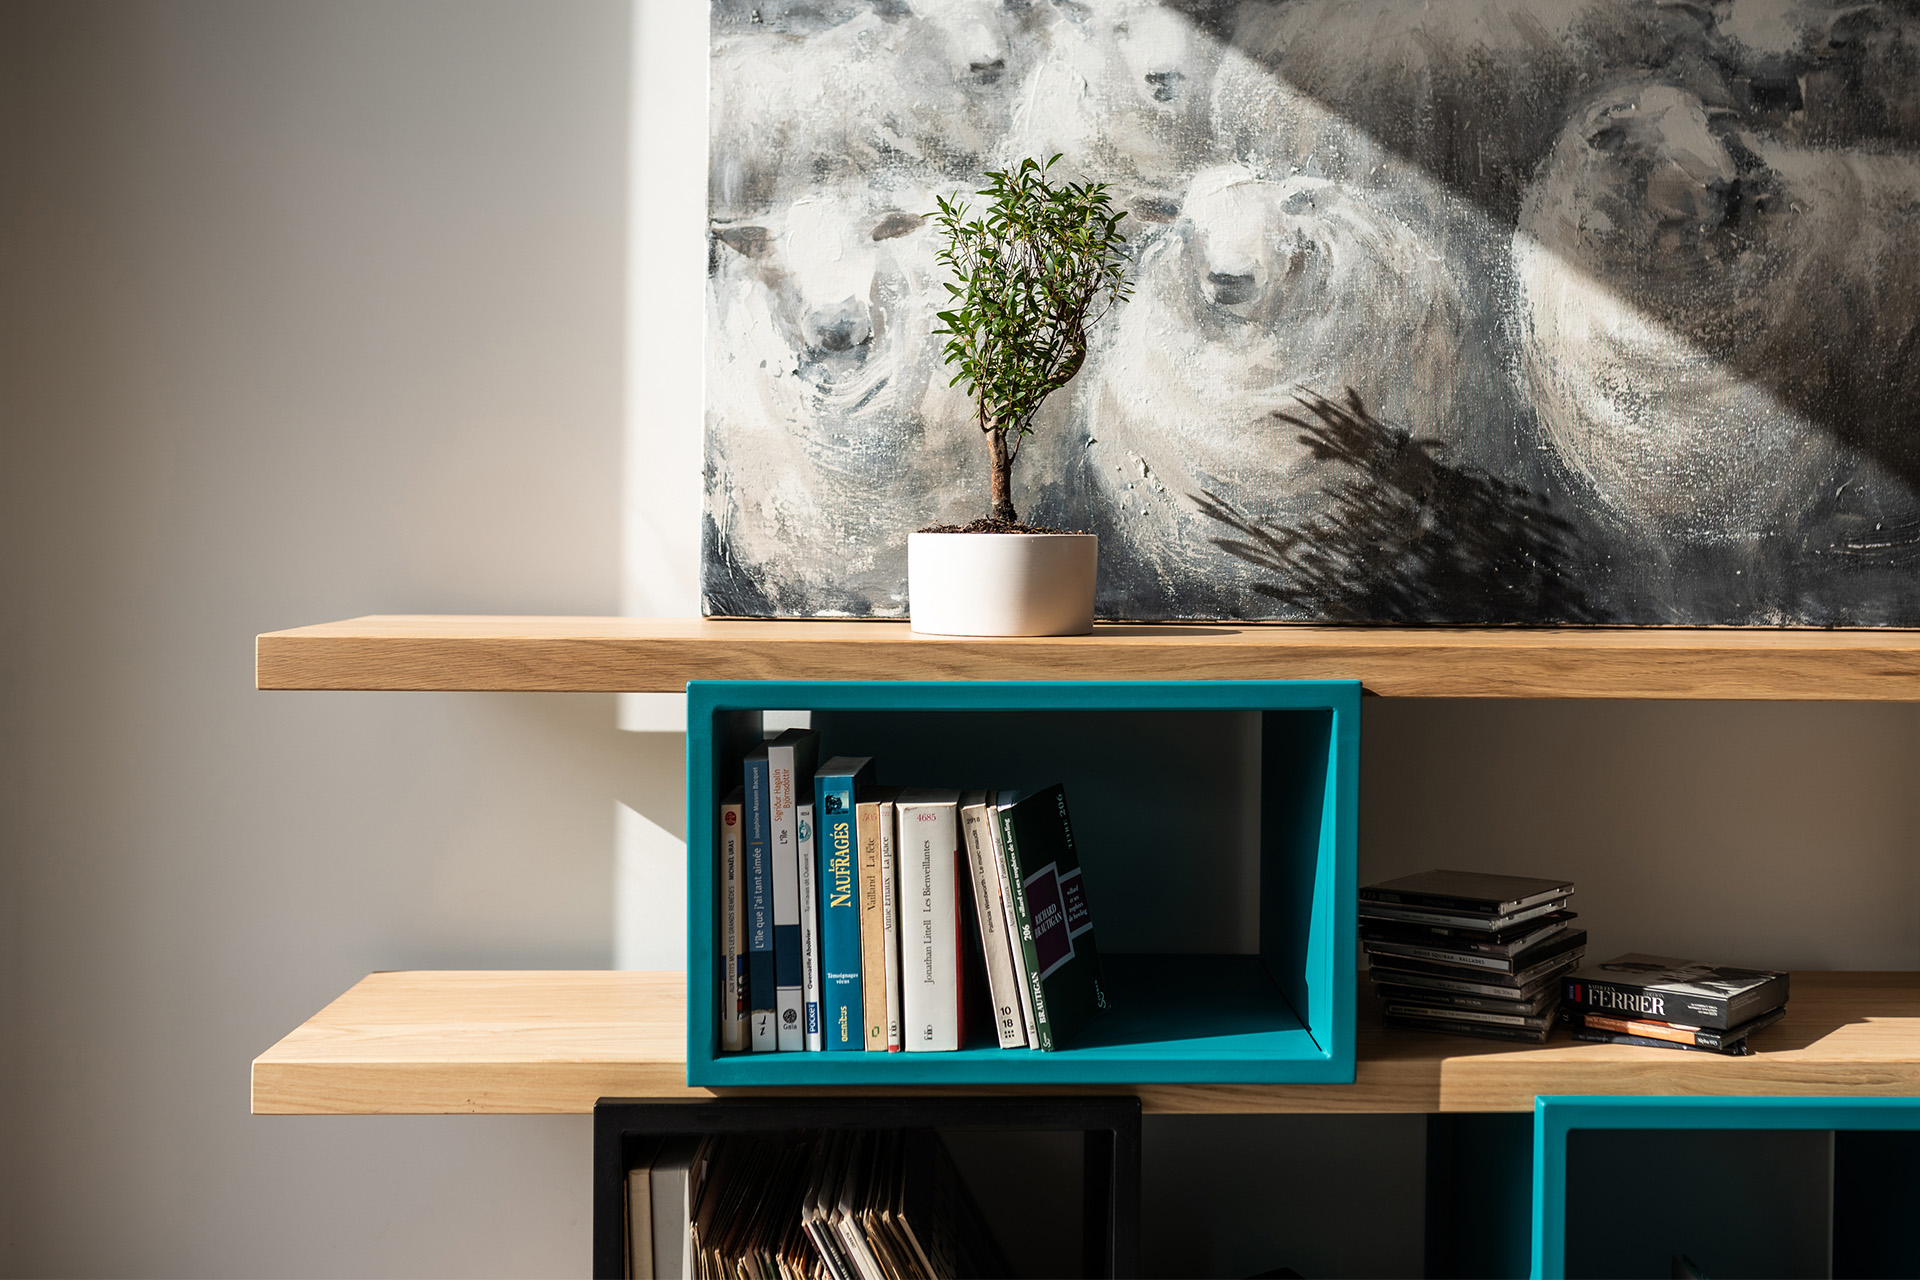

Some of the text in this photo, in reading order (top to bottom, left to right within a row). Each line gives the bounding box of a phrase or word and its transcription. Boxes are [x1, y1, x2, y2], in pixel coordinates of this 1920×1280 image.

[1056, 794, 1066, 818] 206
[862, 812, 878, 822] 505
[917, 813, 936, 822] 4685
[882, 836, 892, 858] place
[972, 830, 980, 850] maudit
[1008, 844, 1014, 852] de
[753, 848, 762, 874] aimée
[883, 858, 890, 870] La
[866, 837, 876, 911] Vailland La fête
[754, 876, 762, 895] tant
[980, 878, 992, 910] Wentworth
[756, 911, 764, 928] que
[884, 908, 892, 932] Annie
[922, 840, 935, 984] Jonathan Littell Les Bienveillantes
[1034, 903, 1057, 926] RICHARD
[1022, 924, 1032, 941] 206
[1034, 911, 1063, 939] BRAUTIGAN
[1458, 956, 1485, 964] BALLADES
[1031, 972, 1046, 1024] BRAUTIGAN
[1588, 988, 1666, 1016] FERRIER
[1000, 1006, 1012, 1016] 10
[1003, 1019, 1013, 1028] 18
